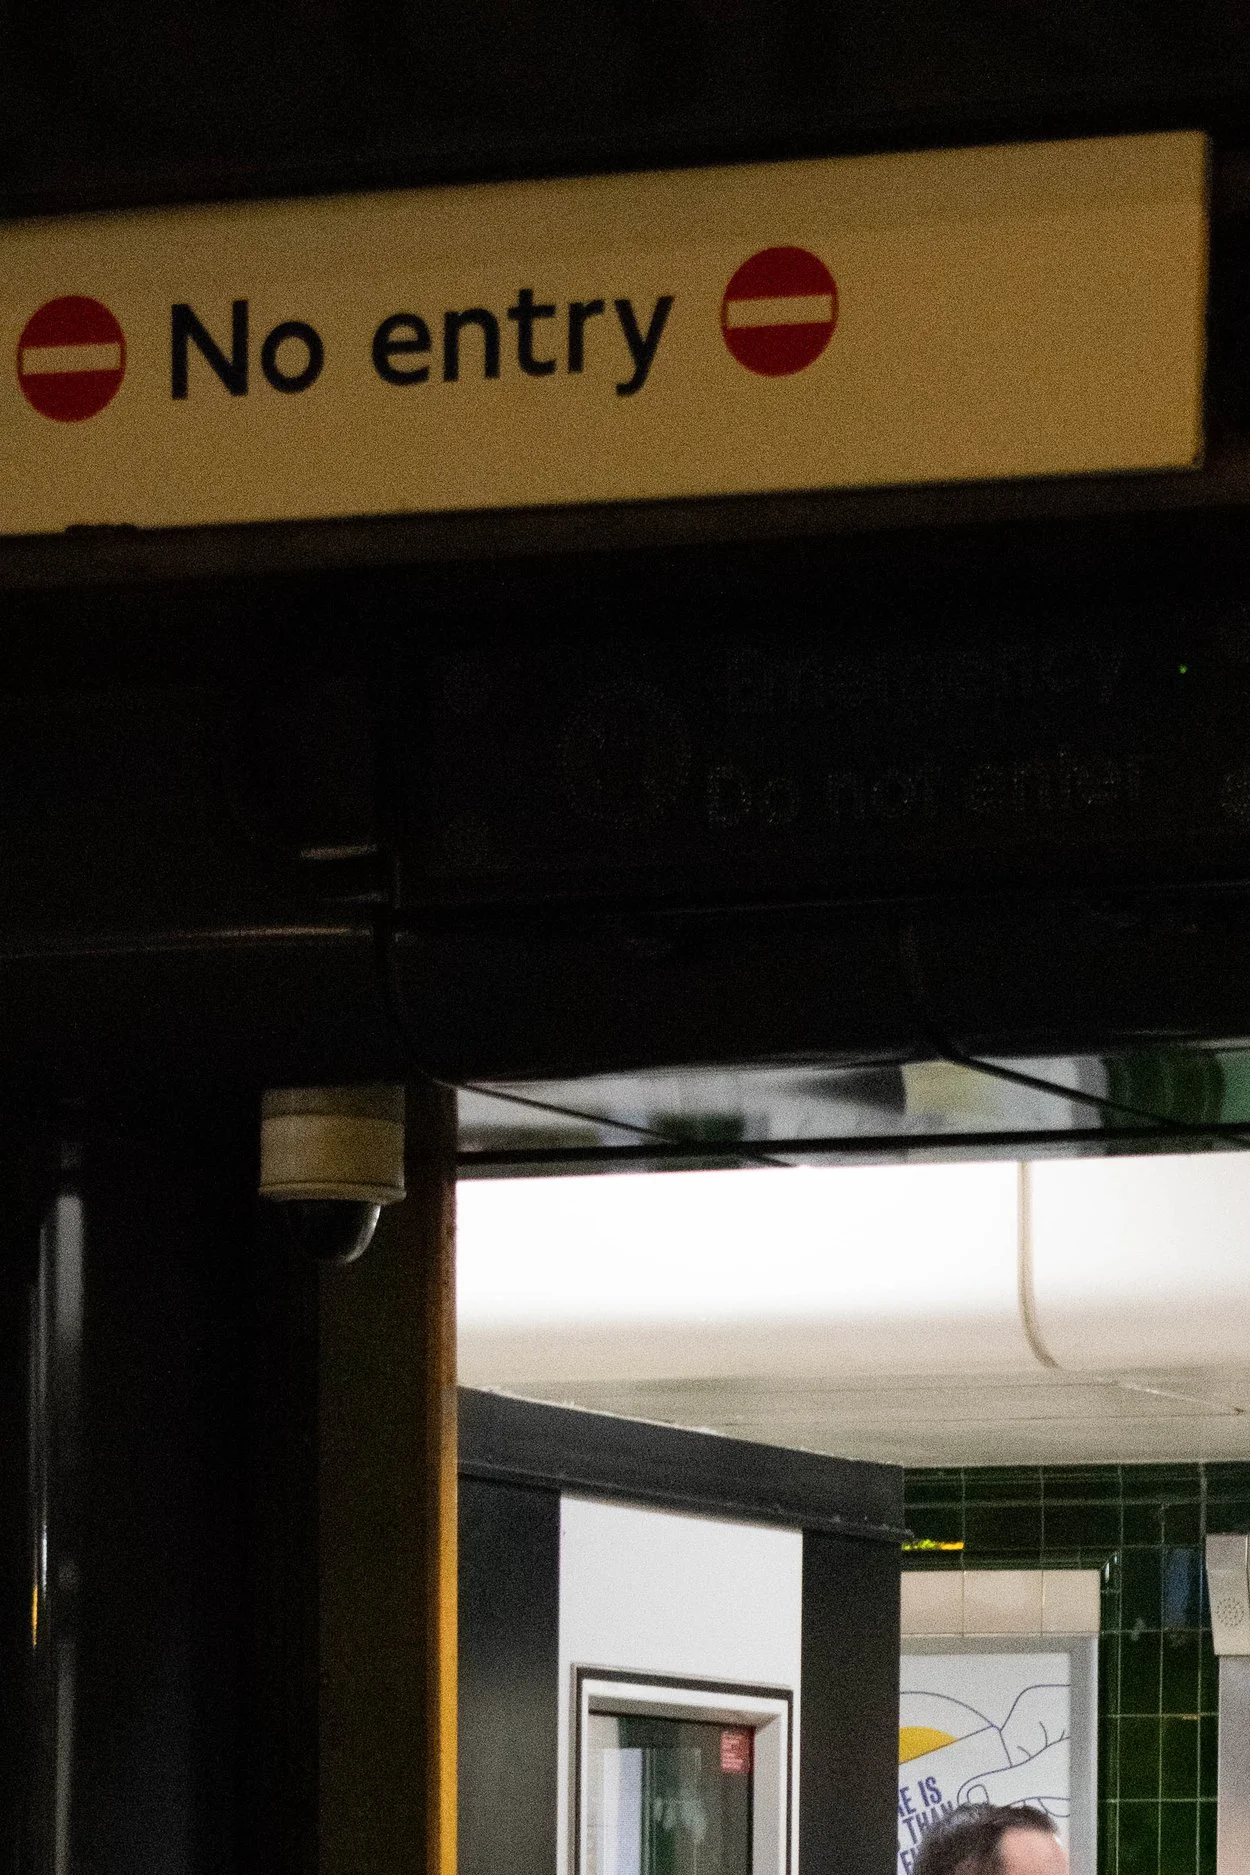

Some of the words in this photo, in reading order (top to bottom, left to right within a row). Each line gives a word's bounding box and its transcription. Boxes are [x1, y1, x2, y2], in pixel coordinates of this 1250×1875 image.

[169, 299, 326, 400] No
[370, 287, 676, 398] entry
[918, 1776, 942, 1807] IS
